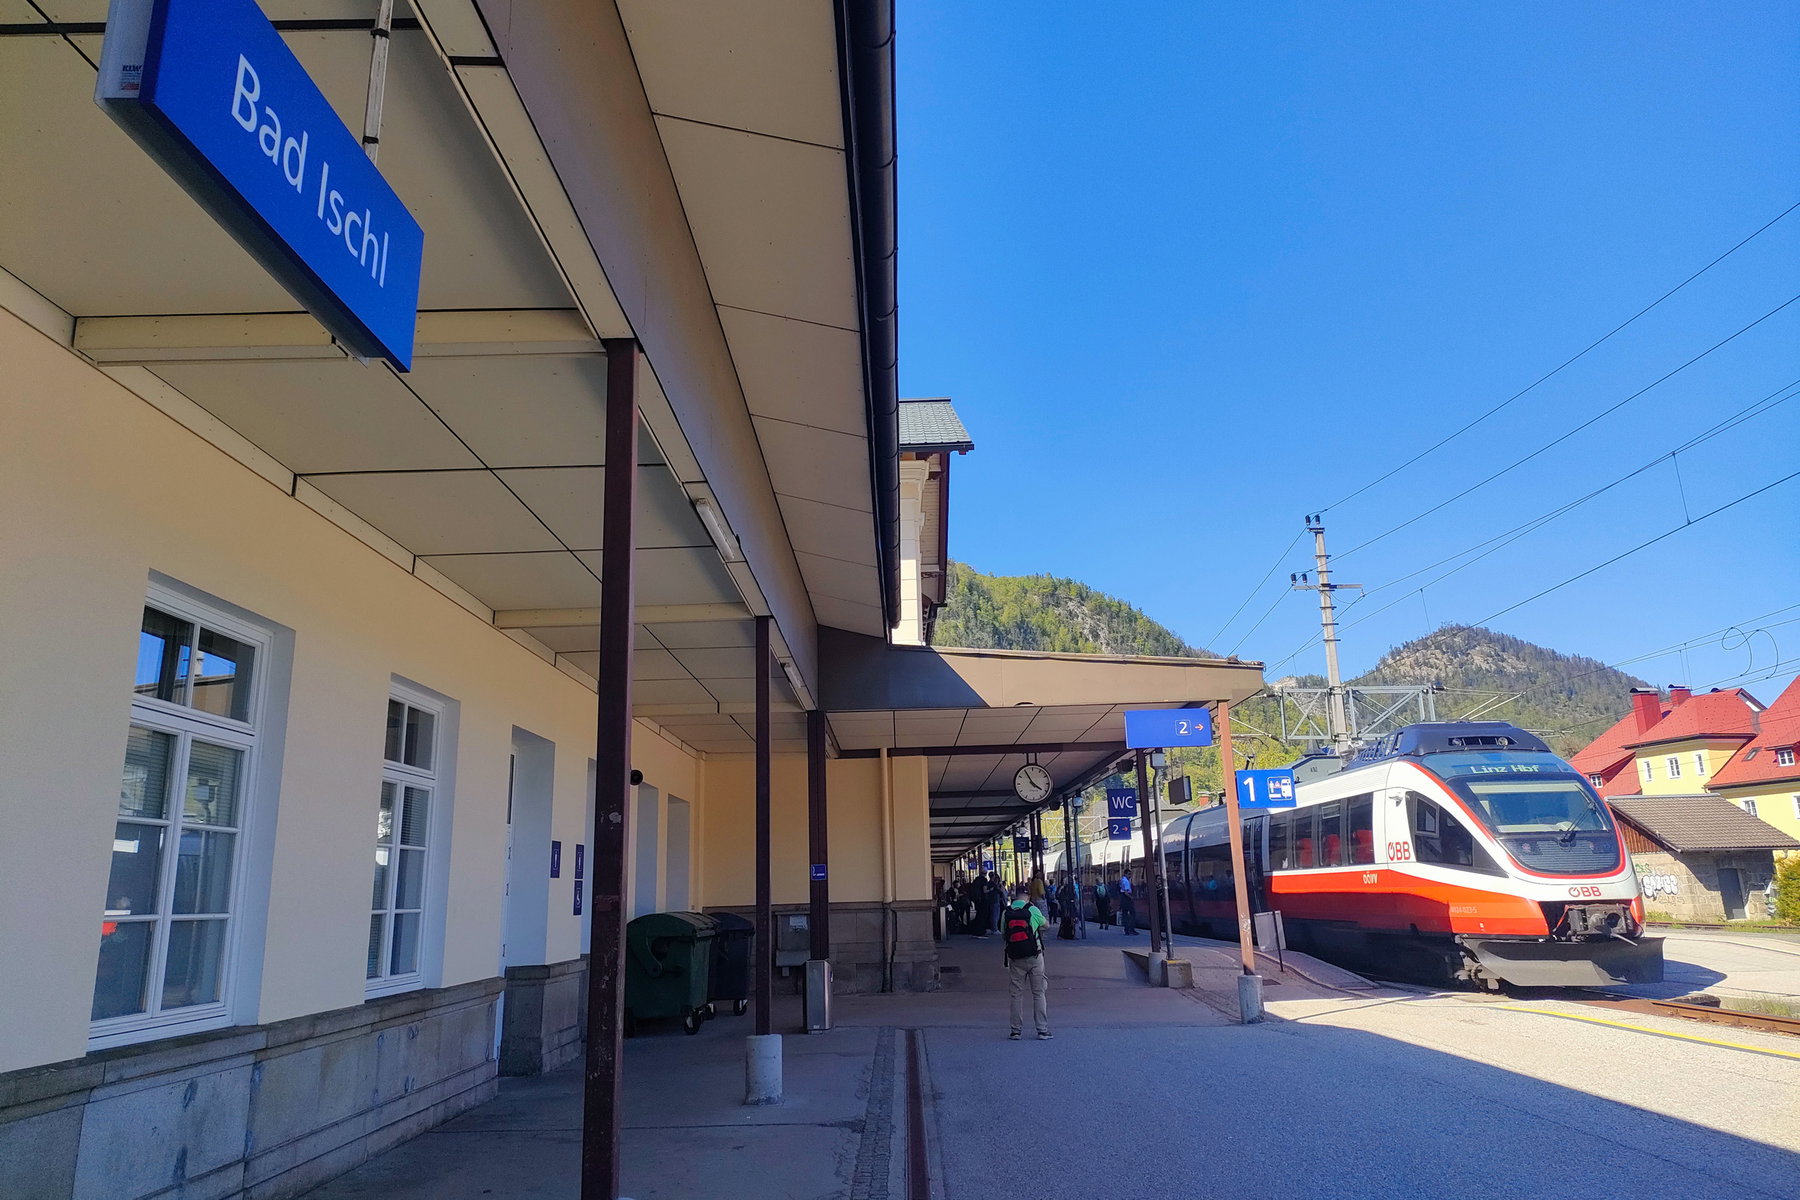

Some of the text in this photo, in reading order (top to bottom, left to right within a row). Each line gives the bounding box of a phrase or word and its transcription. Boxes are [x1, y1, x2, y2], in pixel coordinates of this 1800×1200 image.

[231, 53, 389, 289] Bad Ischl
[1179, 721, 1188, 734] 2
[1471, 764, 1539, 774] Linz Hbf
[1243, 777, 1256, 802] 1
[1112, 795, 1134, 810] WC
[1112, 824, 1120, 835] 2
[1387, 841, 1411, 861] ÖBB
[1568, 886, 1601, 898] ÖBB
